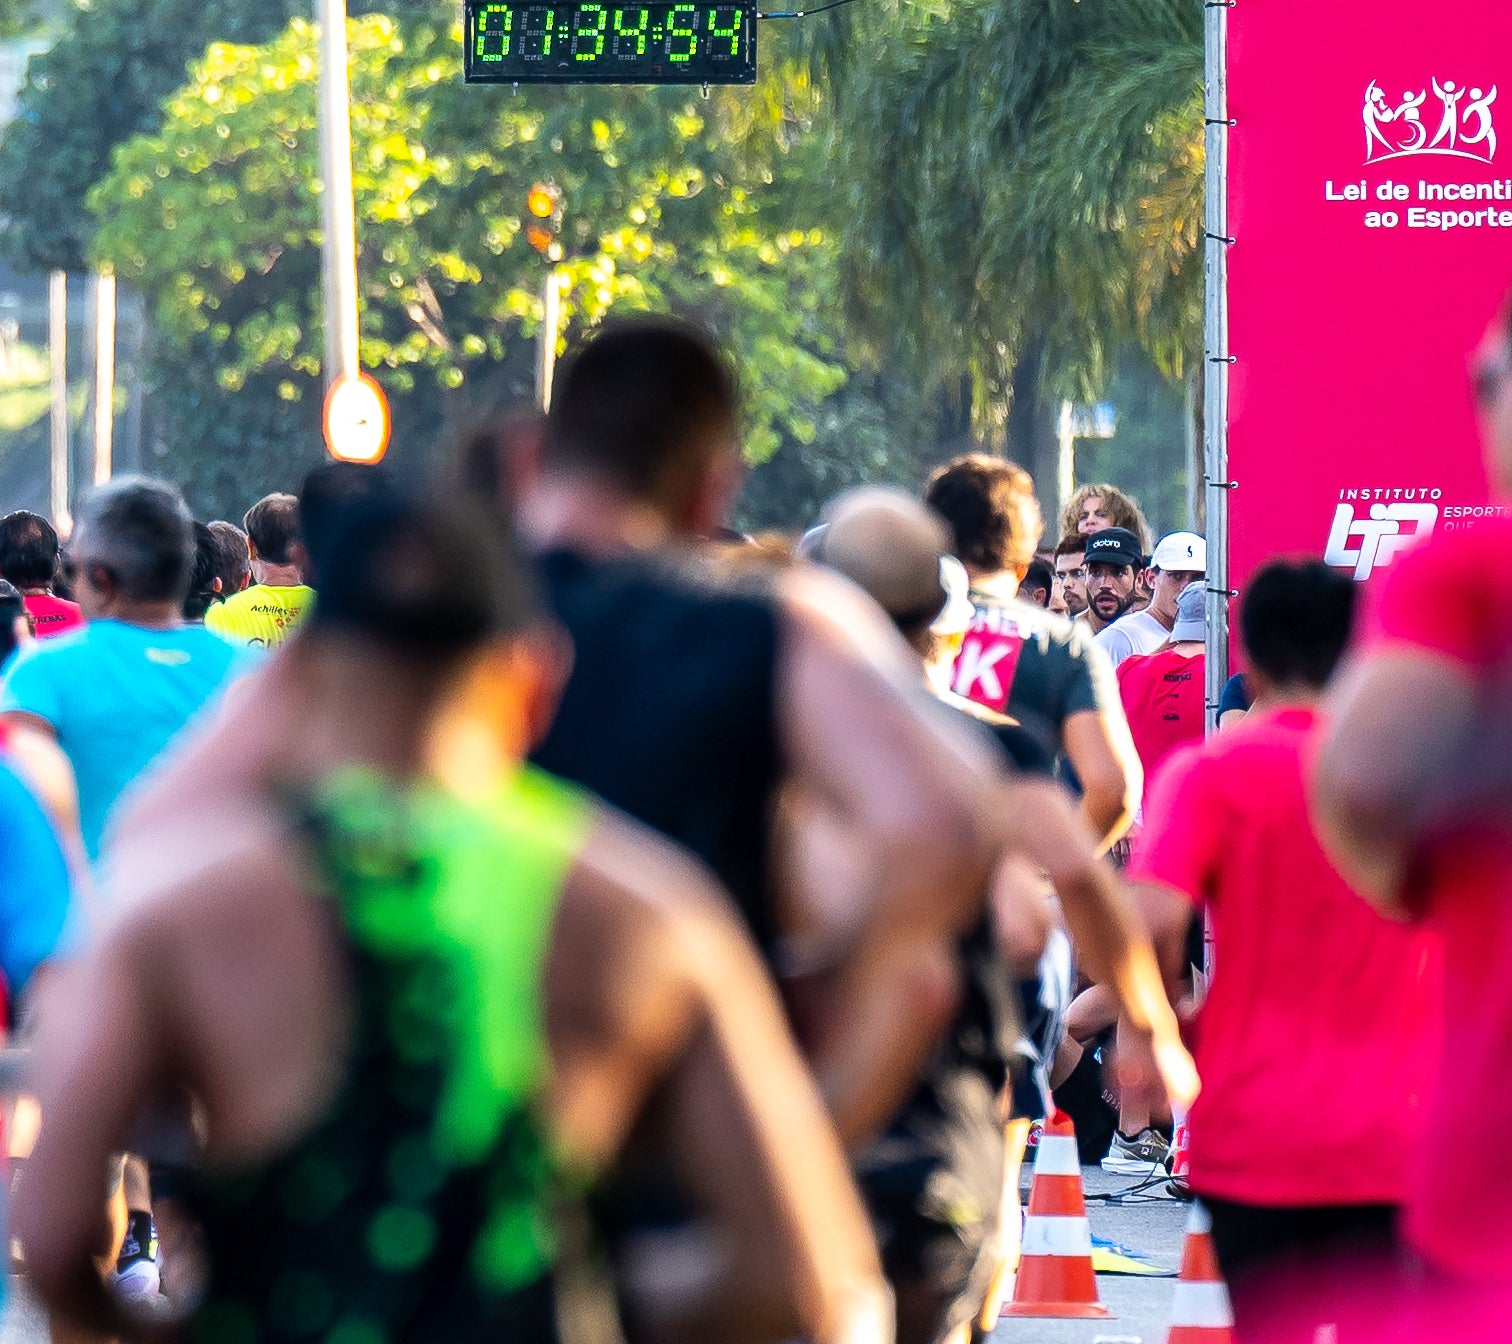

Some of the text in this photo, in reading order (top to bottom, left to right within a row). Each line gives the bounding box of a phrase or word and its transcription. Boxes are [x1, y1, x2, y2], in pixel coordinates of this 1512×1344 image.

[477, 4, 742, 61] 01:34:54
[1325, 180, 1367, 201] Lei
[1376, 181, 1409, 201] de
[1364, 212, 1398, 229] ao
[1339, 488, 1442, 500] INSTITUTO
